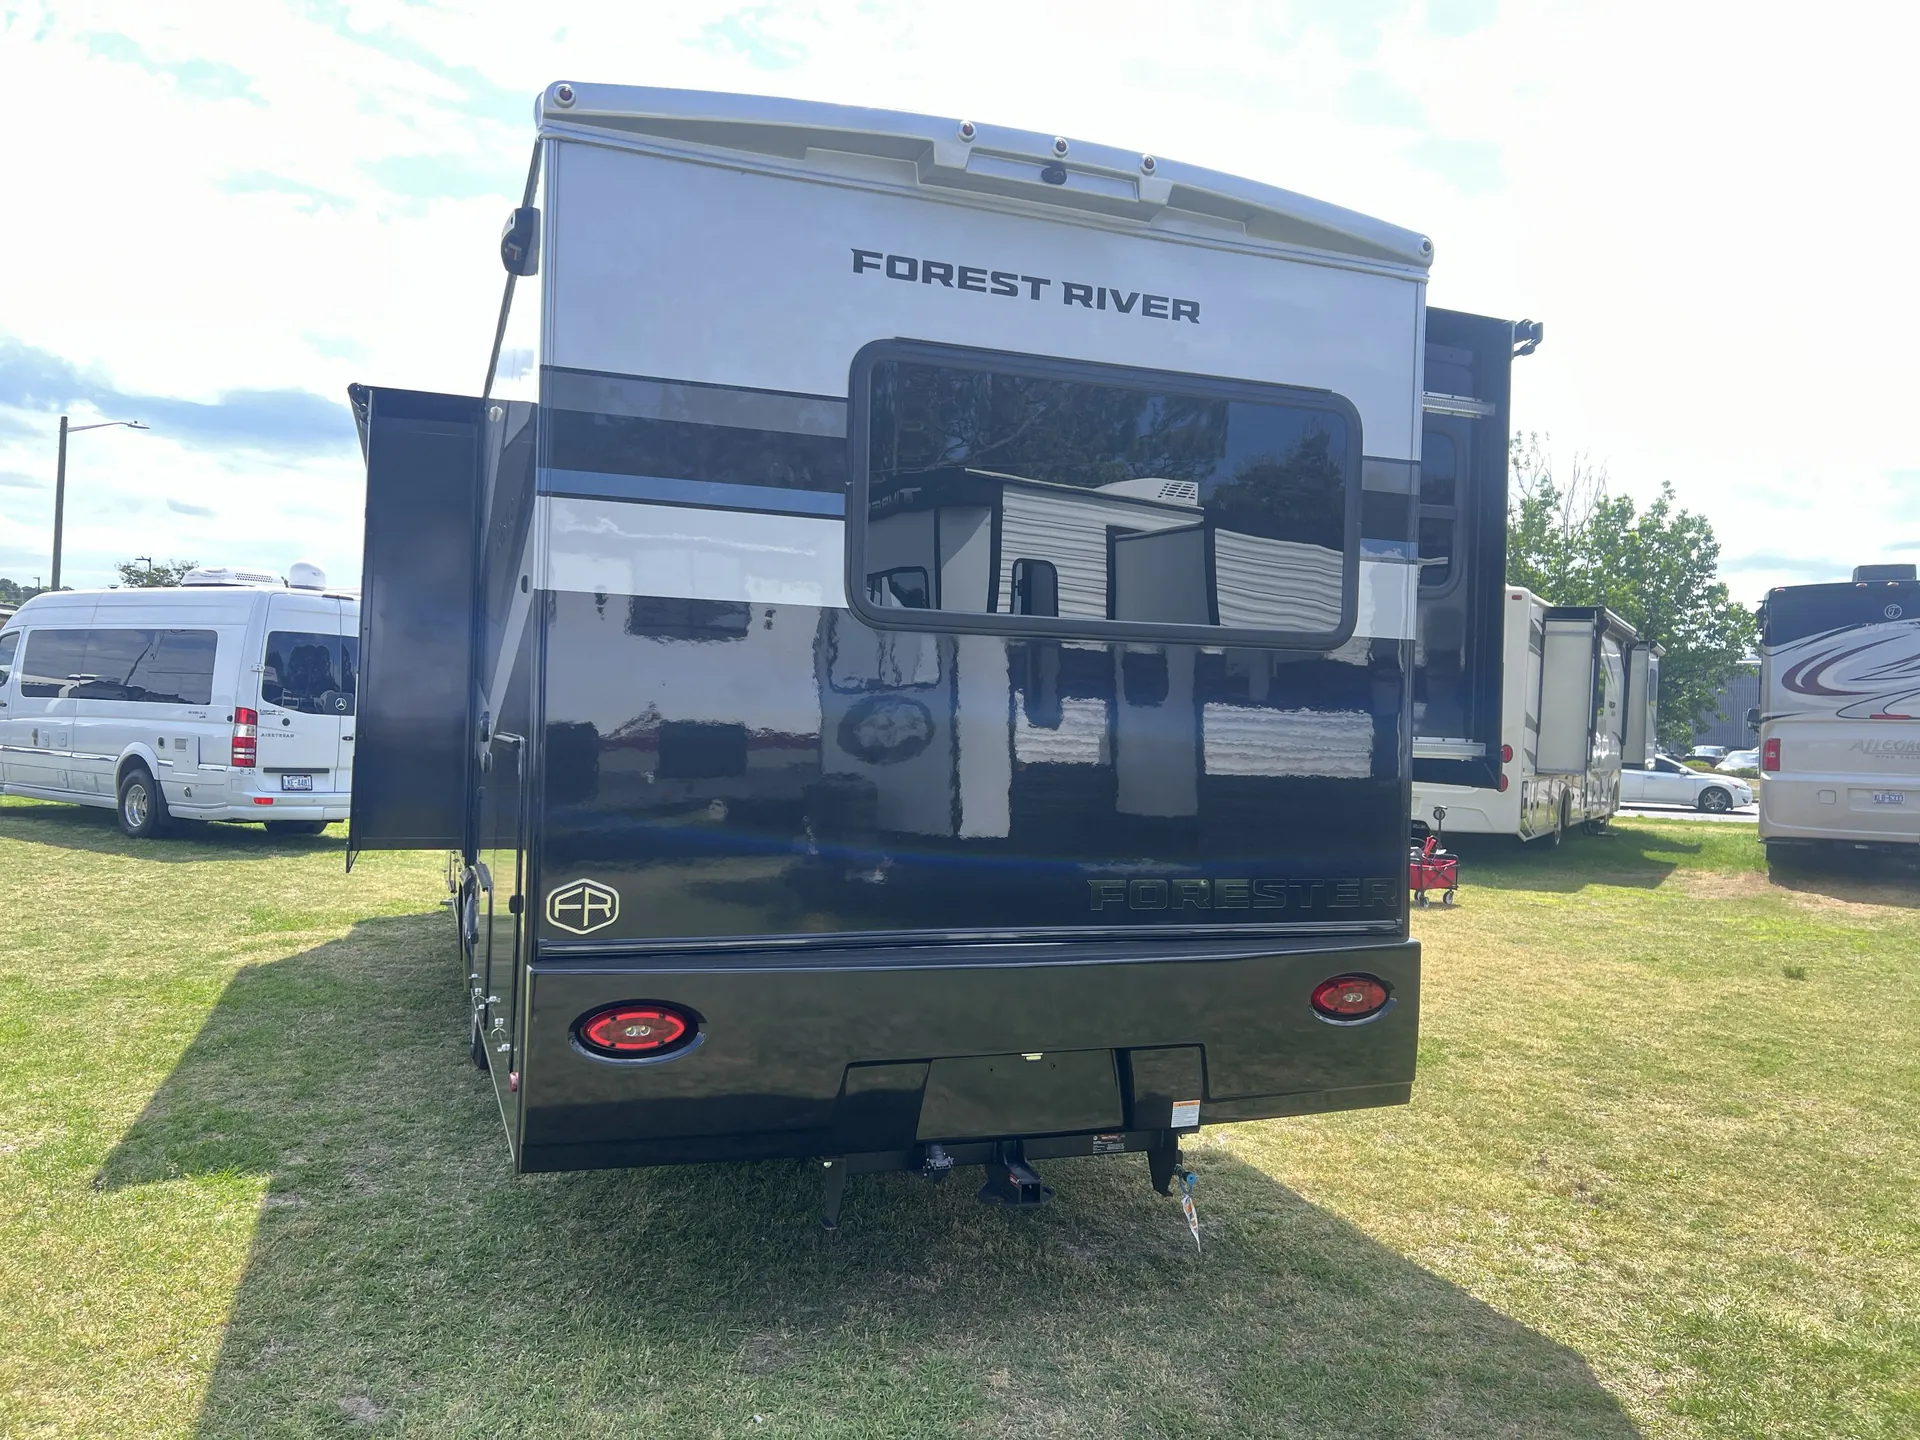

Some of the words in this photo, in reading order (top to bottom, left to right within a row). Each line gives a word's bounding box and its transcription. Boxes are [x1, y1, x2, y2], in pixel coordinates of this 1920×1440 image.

[850, 248, 1051, 300] FOREST
[1061, 281, 1201, 324] RIVER
[1086, 878, 1399, 911] FORESTER
